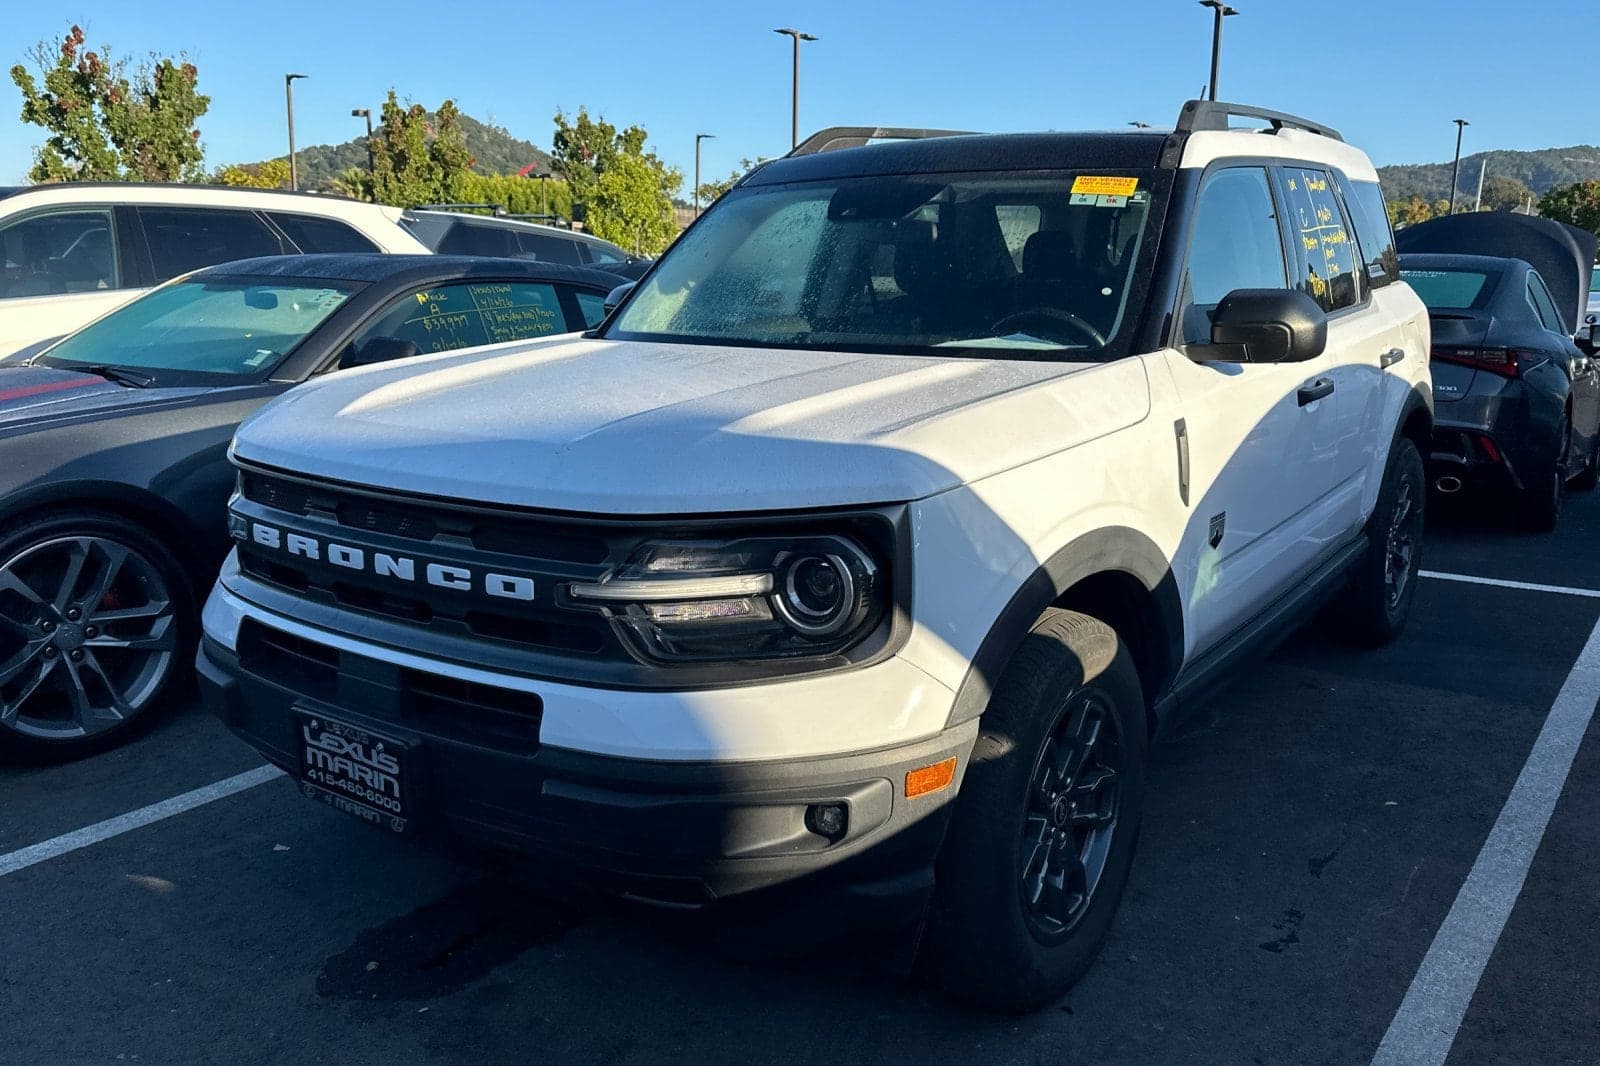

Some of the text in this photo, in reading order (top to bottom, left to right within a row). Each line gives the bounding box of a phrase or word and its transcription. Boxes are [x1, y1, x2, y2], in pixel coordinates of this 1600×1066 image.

[252, 522, 535, 601] BRONCO
[302, 724, 400, 776] LEXUS
[306, 745, 401, 798] MARIN
